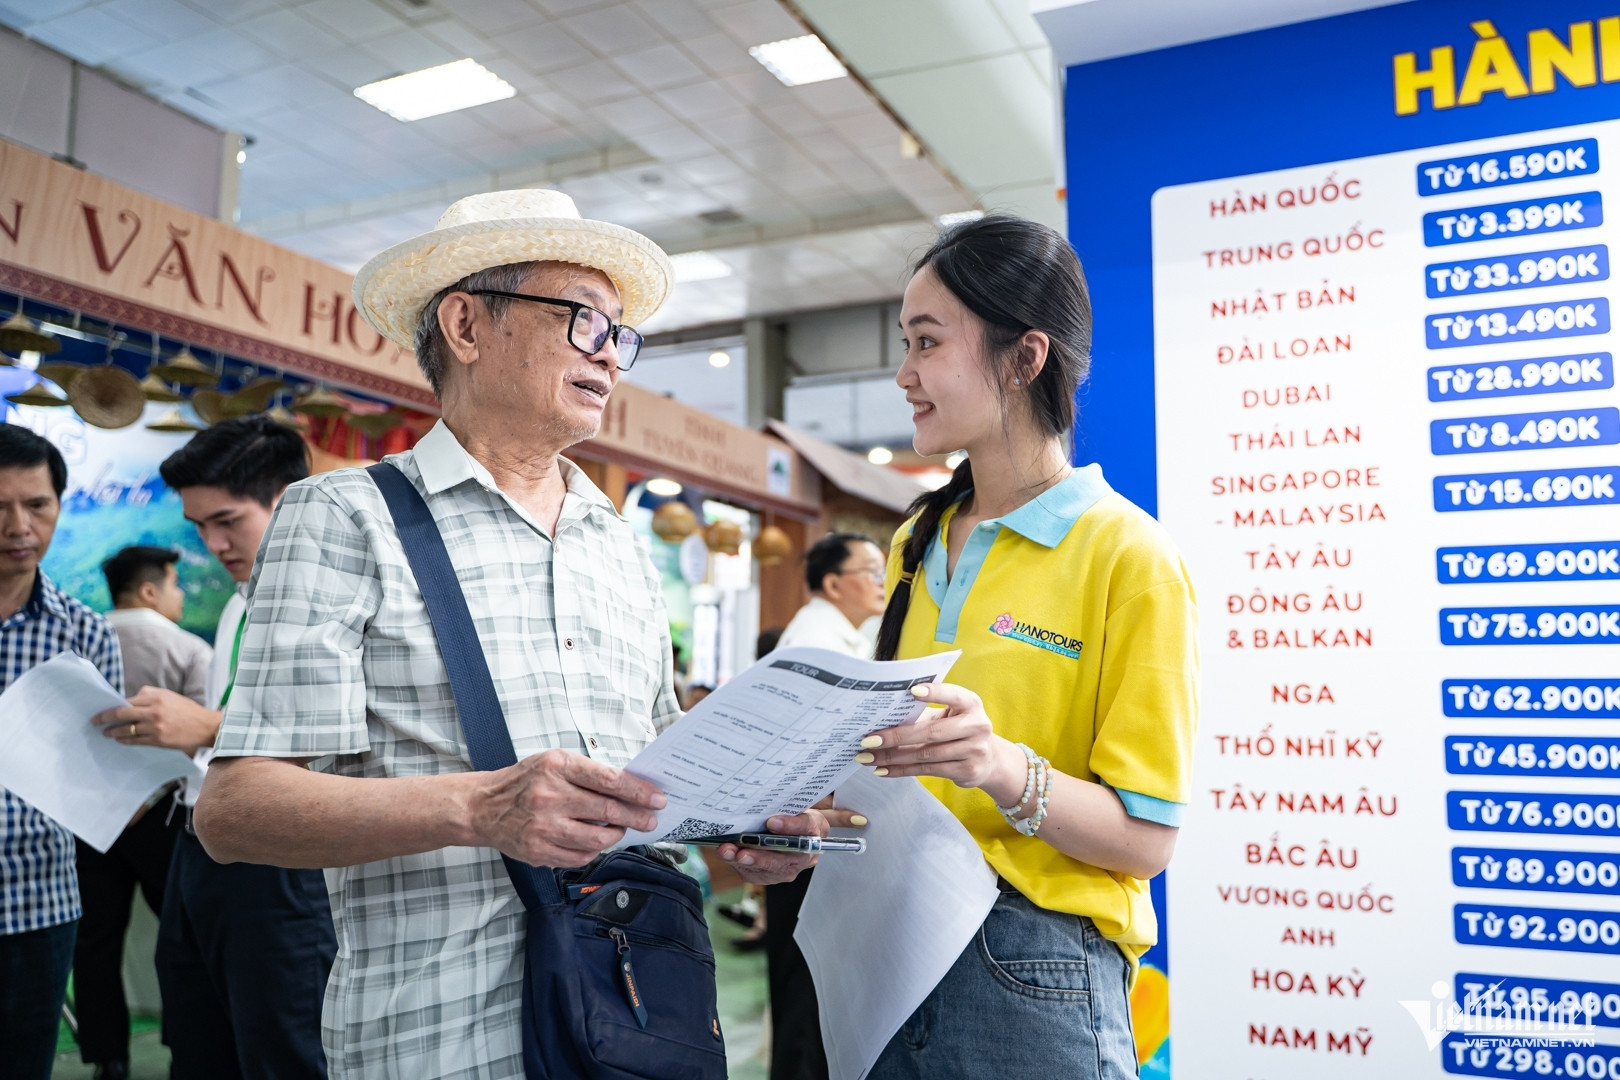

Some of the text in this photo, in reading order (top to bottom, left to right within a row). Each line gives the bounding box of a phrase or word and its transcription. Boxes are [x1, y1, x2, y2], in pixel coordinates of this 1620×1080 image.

[1424, 146, 1588, 190] Từ 16.590K
[1209, 170, 1362, 218] HÀN QUỐC
[1436, 199, 1585, 240] Từ 3.399K
[1202, 220, 1385, 268] TRUNG QUỐC
[77, 199, 276, 325] VĂN
[302, 281, 416, 364] HO
[1430, 252, 1600, 293] Từ 33.990K
[1210, 279, 1356, 319] NHẬT BẢN
[1431, 303, 1597, 341] Từ 13.490K
[1217, 334, 1352, 365] ĐÀI LOAN
[1431, 357, 1604, 394] Từ 28.990K
[1243, 383, 1331, 409] DUBAI
[1228, 423, 1361, 451] THÁI LAN
[1445, 415, 1601, 449] Từ 8.490K
[1211, 466, 1381, 496] SINGAPORE
[1444, 473, 1615, 506] Từ 15.690K
[1233, 503, 1387, 528] MALAYSIA
[1245, 541, 1353, 570] TÂY ÂU
[1442, 548, 1620, 578] Từ 69.900K
[1227, 584, 1364, 614] ĐÔNG ÂU
[1014, 622, 1083, 652] HANOTOURS
[1227, 628, 1373, 649] & BALKAN
[1446, 611, 1620, 639] Từ 75.900K
[790, 663, 819, 677] TOUR
[1271, 683, 1335, 704] NGA
[1447, 684, 1491, 711] Từ
[1215, 723, 1383, 758] THỔ NHĨ KỸ
[1452, 741, 1496, 768] Từ
[1210, 782, 1397, 816] TÂY NAM ÂU
[1459, 798, 1620, 830] Từ 76.900
[1245, 831, 1358, 869] BẮC ÂU
[1458, 855, 1620, 887] Từ 89.900
[1217, 882, 1395, 914] VƯƠNG QUỐC
[1281, 926, 1335, 947] ANH
[1461, 911, 1505, 938] Từ
[1252, 967, 1366, 998] HOA KỲ
[1249, 1023, 1373, 1056] NAM MỸ
